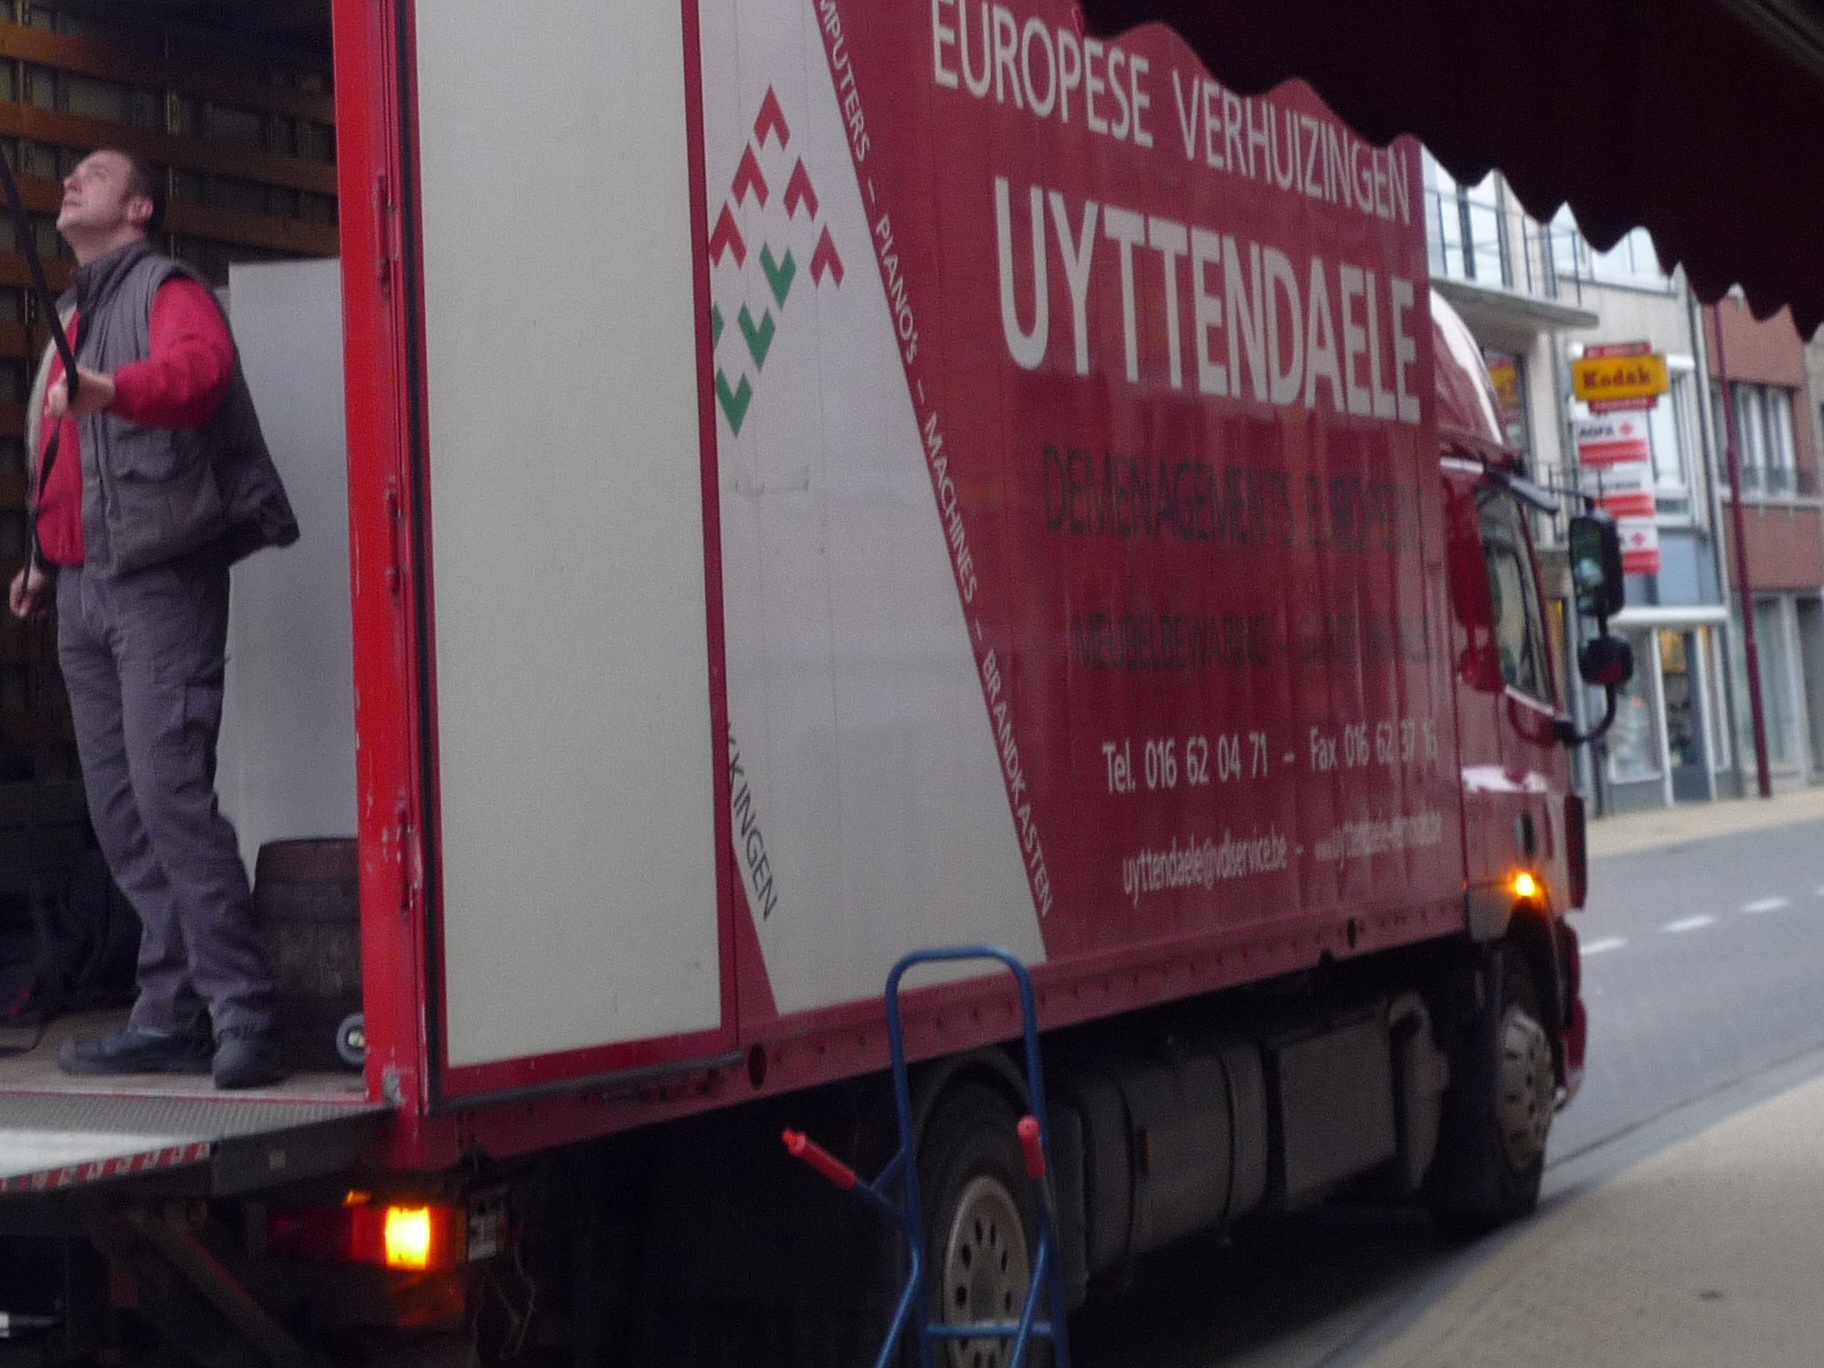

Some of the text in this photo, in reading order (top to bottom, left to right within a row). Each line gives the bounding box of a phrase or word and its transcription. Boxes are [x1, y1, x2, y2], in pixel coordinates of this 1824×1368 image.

[1172, 68, 1411, 226] VERHUIZINGEN
[994, 176, 1422, 425] UYTTENDAELE
[1584, 364, 1652, 389] Kodak
[925, 412, 977, 604] MACHINES
[728, 729, 779, 922] KINGEN
[1102, 739, 1136, 794] Tel.
[1145, 737, 1177, 790] 016
[1186, 734, 1210, 787] 62
[1217, 732, 1242, 783] 04
[1249, 729, 1269, 779] 71
[1309, 725, 1338, 772] Fax
[1344, 720, 1370, 769] 016
